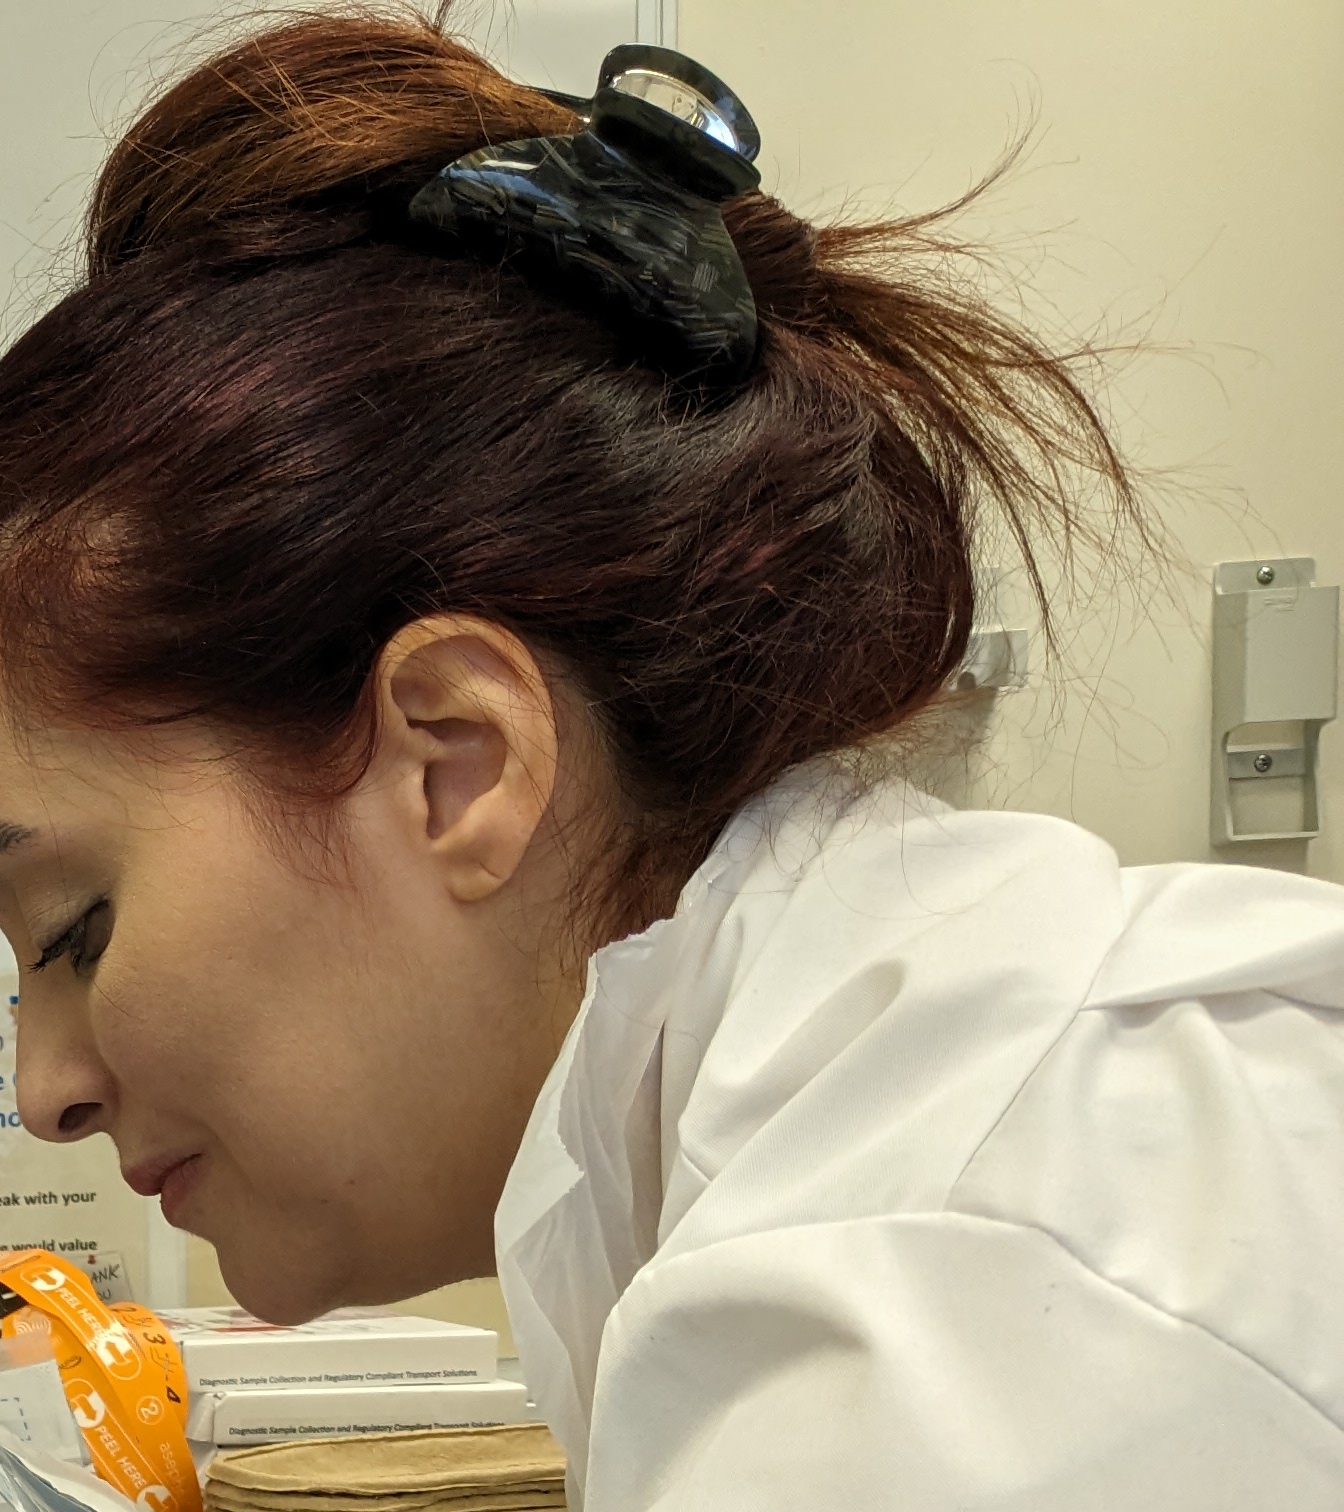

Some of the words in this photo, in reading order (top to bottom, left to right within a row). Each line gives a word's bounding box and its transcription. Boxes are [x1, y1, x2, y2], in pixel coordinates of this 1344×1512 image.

[23, 1191, 58, 1205] with
[61, 1191, 97, 1204] your
[11, 1240, 55, 1253] would
[59, 1238, 98, 1252] value
[93, 1264, 120, 1283] ANK
[58, 1285, 82, 1314] PEEL
[199, 1376, 238, 1387] Diagnostic
[240, 1376, 267, 1386] Sample
[269, 1374, 307, 1384] Collection
[308, 1374, 322, 1383] and
[324, 1372, 364, 1383] Regulatory
[366, 1371, 404, 1381] Compliant
[406, 1369, 441, 1379] Transport
[443, 1369, 477, 1378] Solutions
[229, 1426, 268, 1436] Diagnostic
[269, 1426, 297, 1435] Sample
[299, 1425, 336, 1434] Collection
[337, 1424, 351, 1433] and
[353, 1423, 393, 1433] Regulatory
[96, 1426, 118, 1458] PEEL
[117, 1456, 147, 1490] HERE
